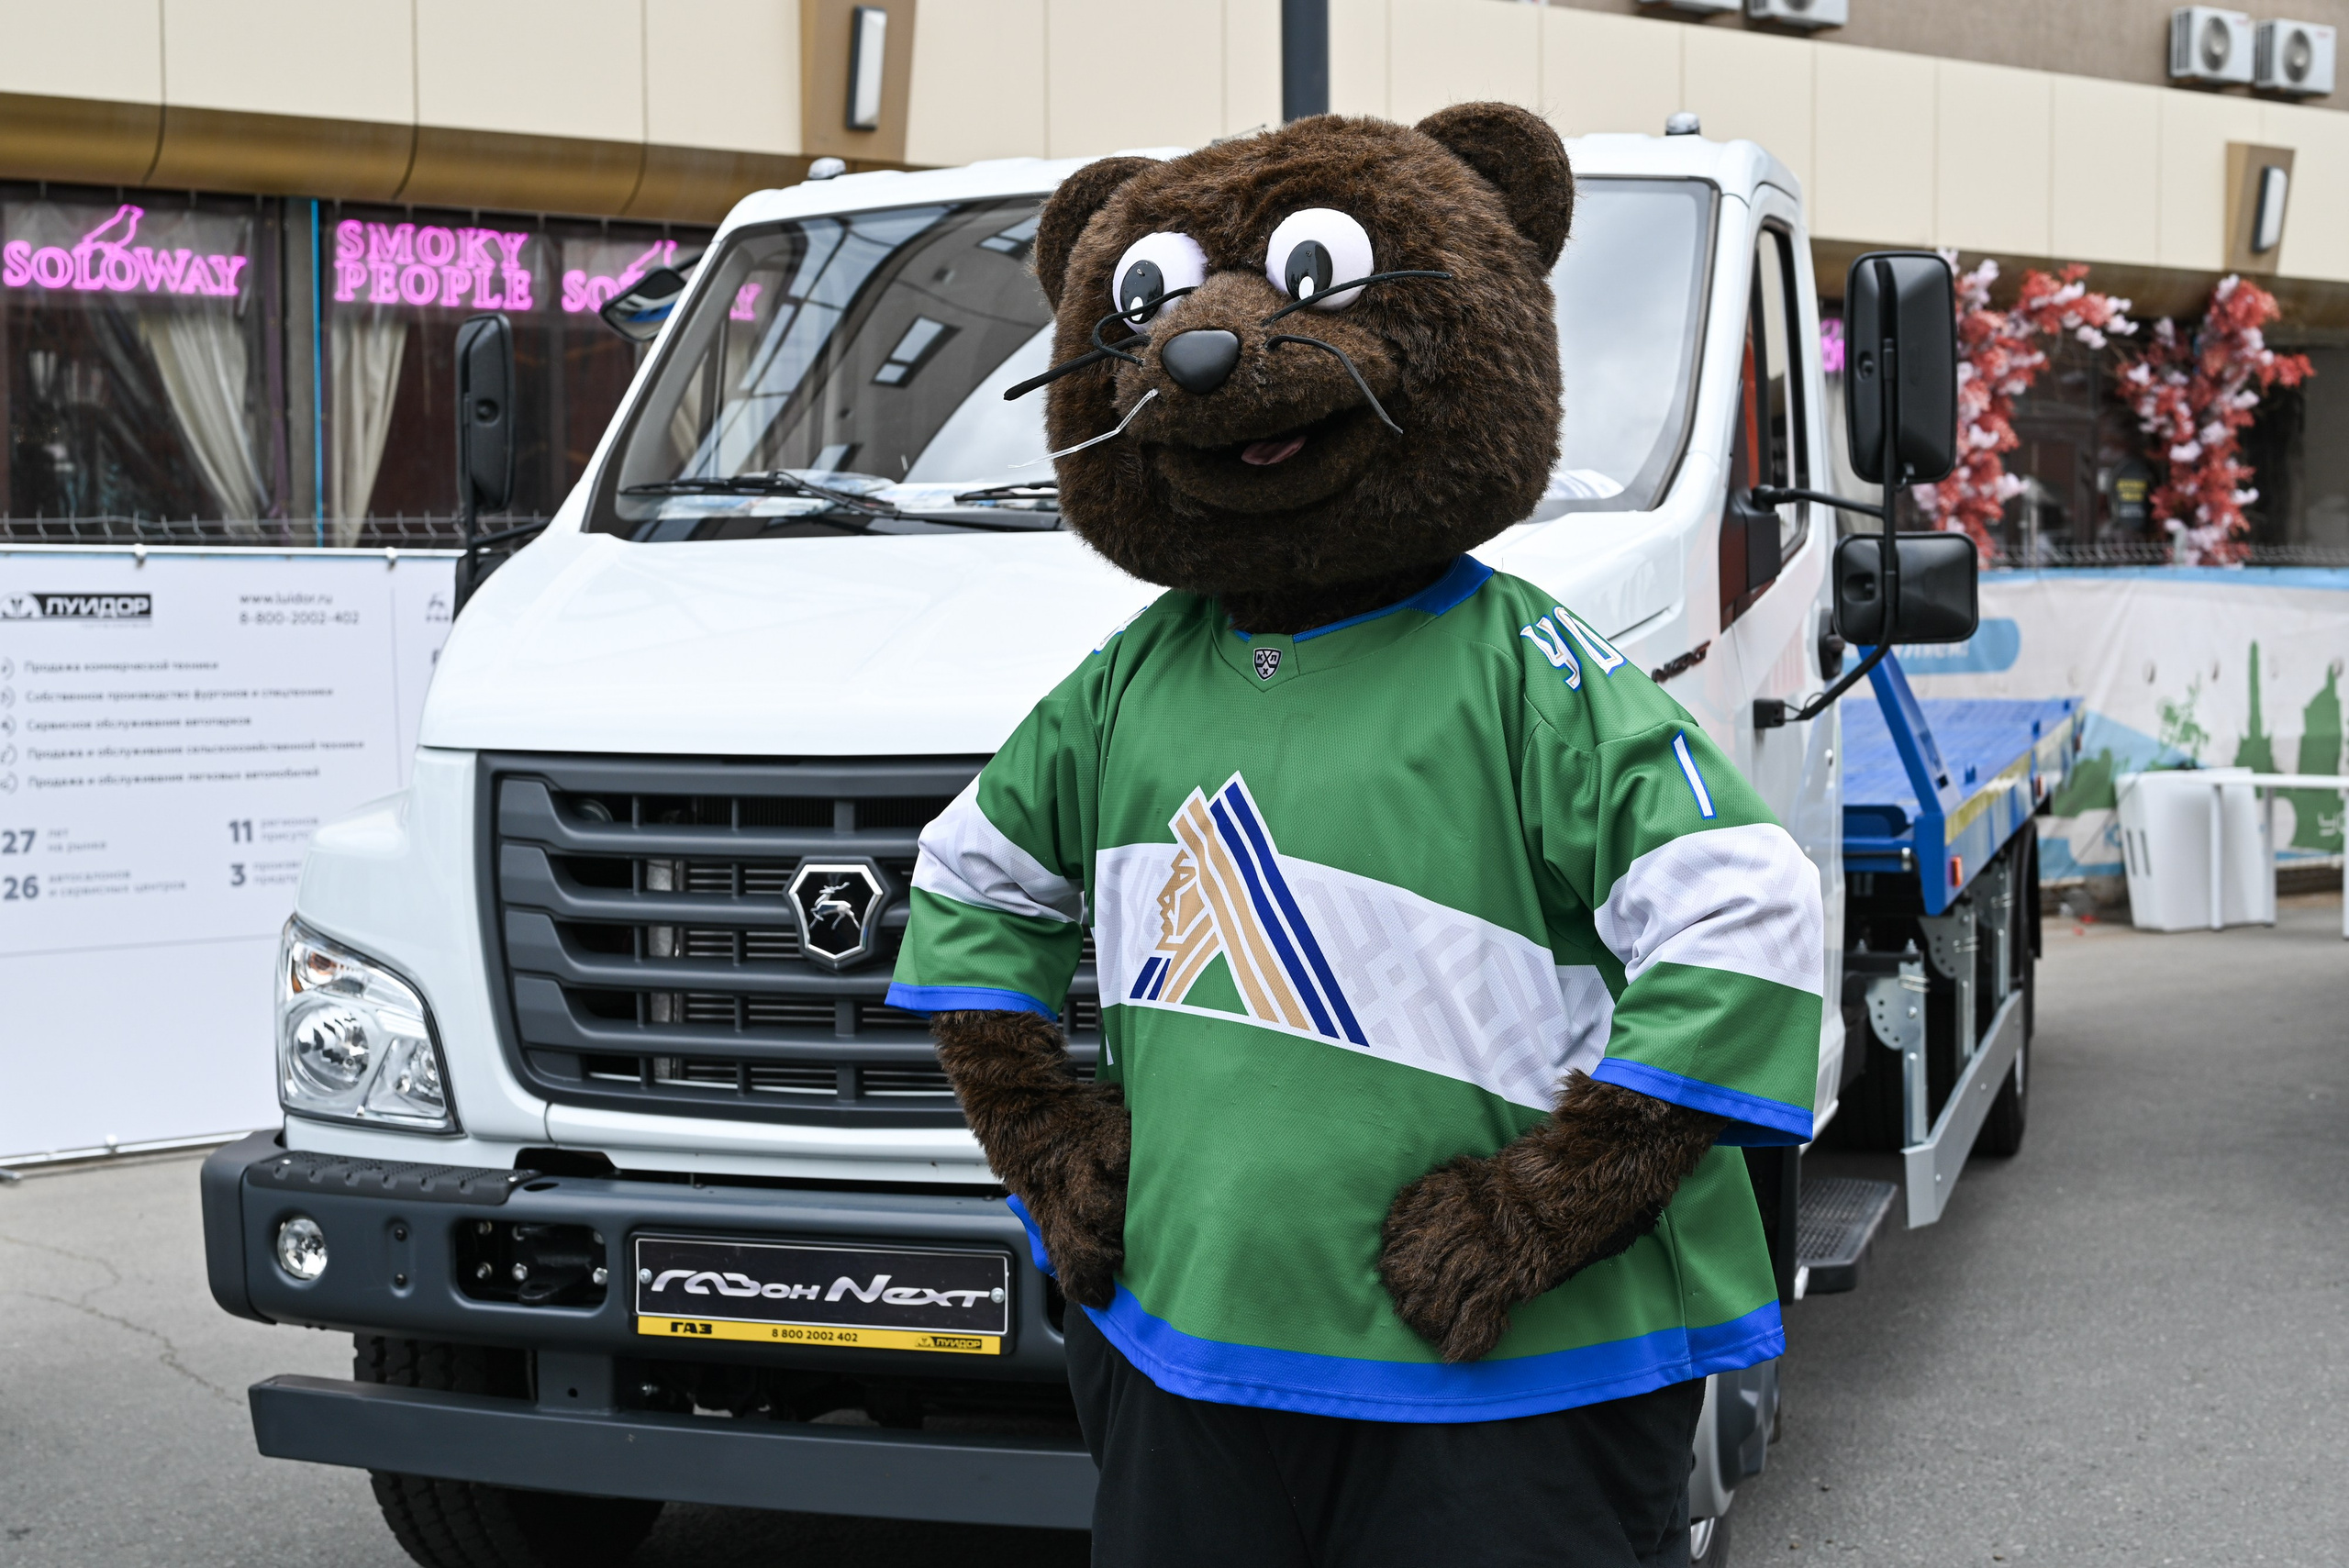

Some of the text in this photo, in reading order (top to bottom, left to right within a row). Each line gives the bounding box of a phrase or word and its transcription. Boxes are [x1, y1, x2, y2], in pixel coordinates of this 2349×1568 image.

[335, 219, 529, 269] SMOKY
[3, 239, 248, 296] SOLOWAY
[334, 261, 534, 311] PEOPLE
[46, 596, 150, 618] ЛУИДОР
[2, 830, 36, 855] 27
[228, 819, 253, 843] 11
[230, 863, 247, 886] 3
[4, 875, 39, 901] 26
[670, 1321, 712, 1335] ГАЗ
[772, 1329, 858, 1342] 8 800 2002 402
[936, 1338, 981, 1350] ЛУИДОР
